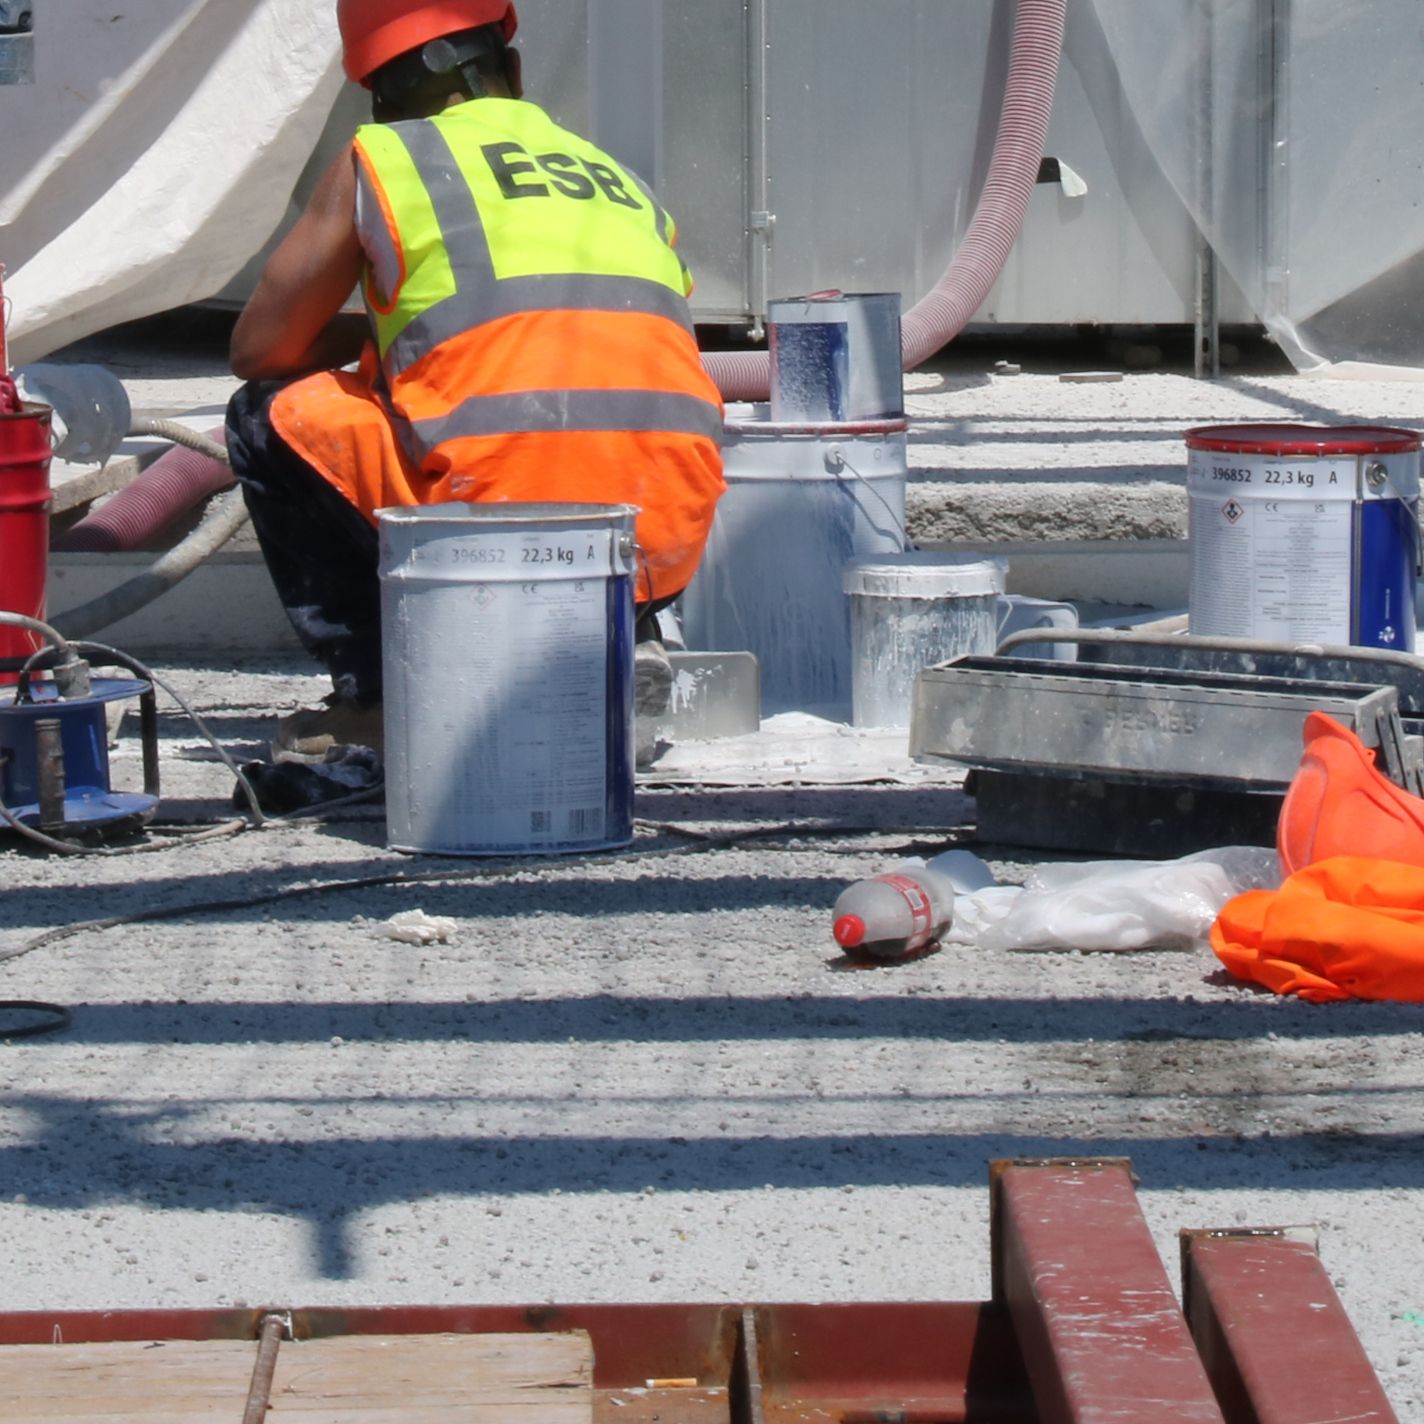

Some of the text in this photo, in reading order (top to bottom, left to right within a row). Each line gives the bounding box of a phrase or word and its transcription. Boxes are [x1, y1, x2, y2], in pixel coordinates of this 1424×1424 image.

[480, 142, 643, 210] ESB
[1212, 467, 1337, 487] 396852 22,3 kg A
[452, 545, 595, 564] 396852 22,3 kg A
